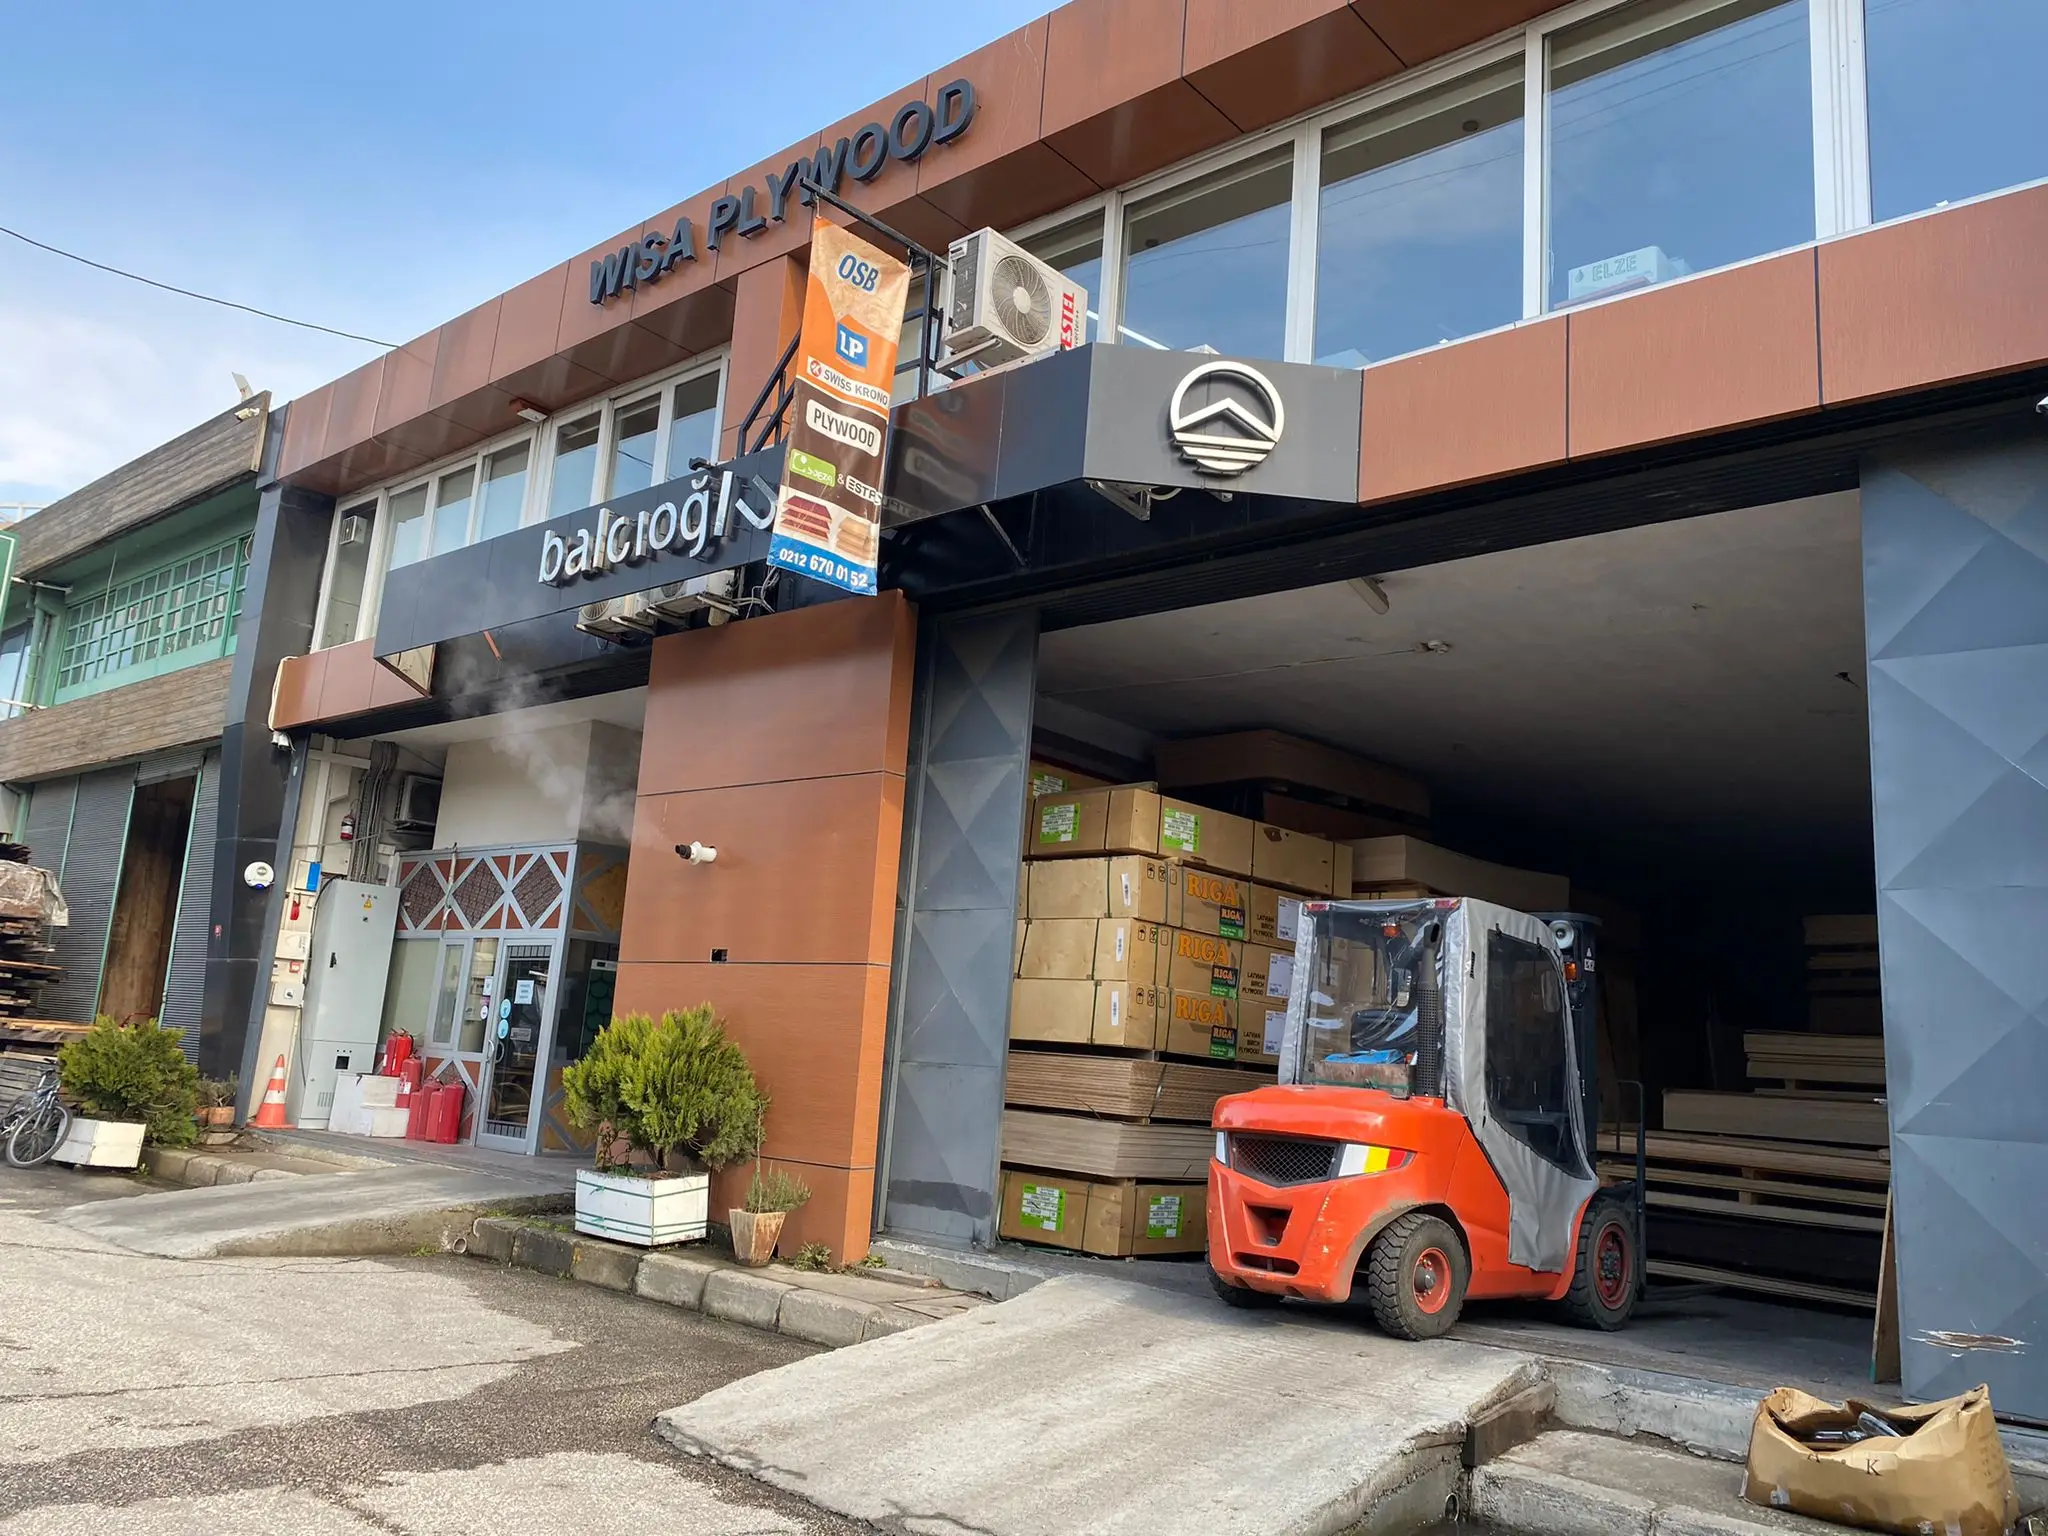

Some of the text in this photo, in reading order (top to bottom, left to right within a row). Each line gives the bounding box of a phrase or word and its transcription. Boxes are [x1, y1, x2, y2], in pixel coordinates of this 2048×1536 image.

[590, 78, 977, 305] WISA PLYWOOD
[838, 254, 879, 292] OSB
[1592, 254, 1637, 282] ELZE
[1061, 293, 1074, 349] ESTEL
[839, 330, 864, 359] LP
[824, 369, 888, 405] SWISS KRONO
[814, 407, 875, 448] PLYWOOD
[780, 548, 868, 587] 0212 670 01 52
[1187, 873, 1238, 906] RIGA
[1221, 908, 1240, 921] RIGA
[1177, 933, 1229, 965] RIGA
[1214, 968, 1233, 980] RIGA
[1175, 995, 1226, 1025] RIGA
[1213, 1027, 1233, 1040] RIGA
